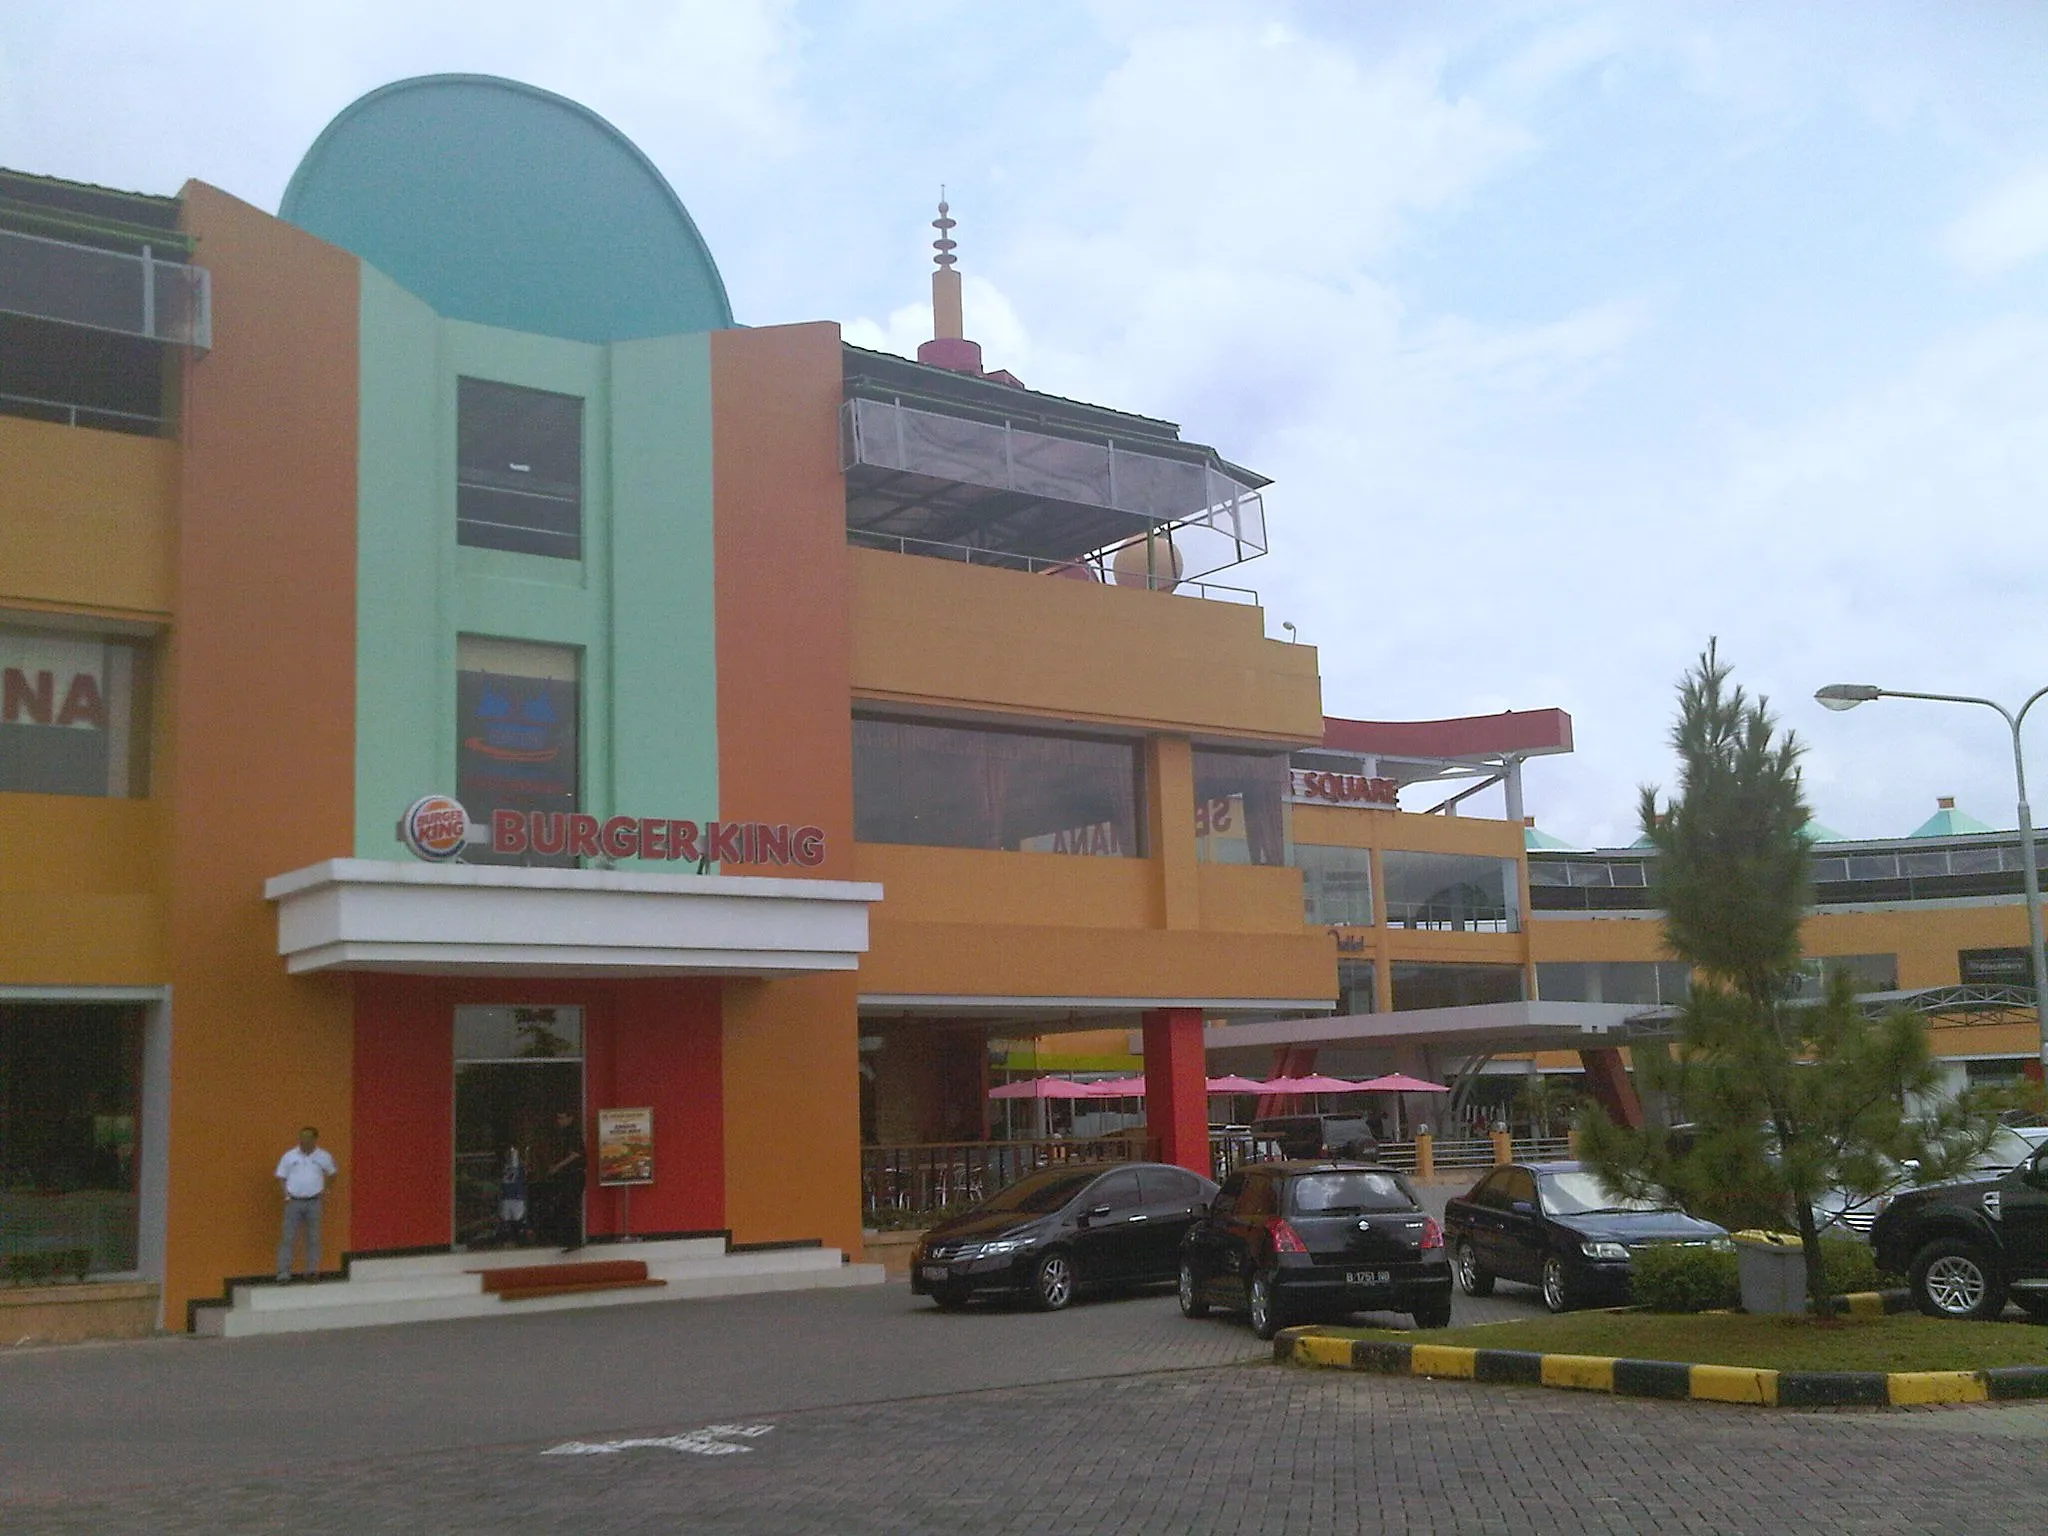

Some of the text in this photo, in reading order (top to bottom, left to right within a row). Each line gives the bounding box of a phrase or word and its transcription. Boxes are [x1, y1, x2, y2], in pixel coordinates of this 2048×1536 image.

[1303, 770, 1399, 804] SQUARE
[415, 811, 464, 829] BURGER
[416, 822, 464, 845] KING
[493, 809, 825, 868] BURGER KING
